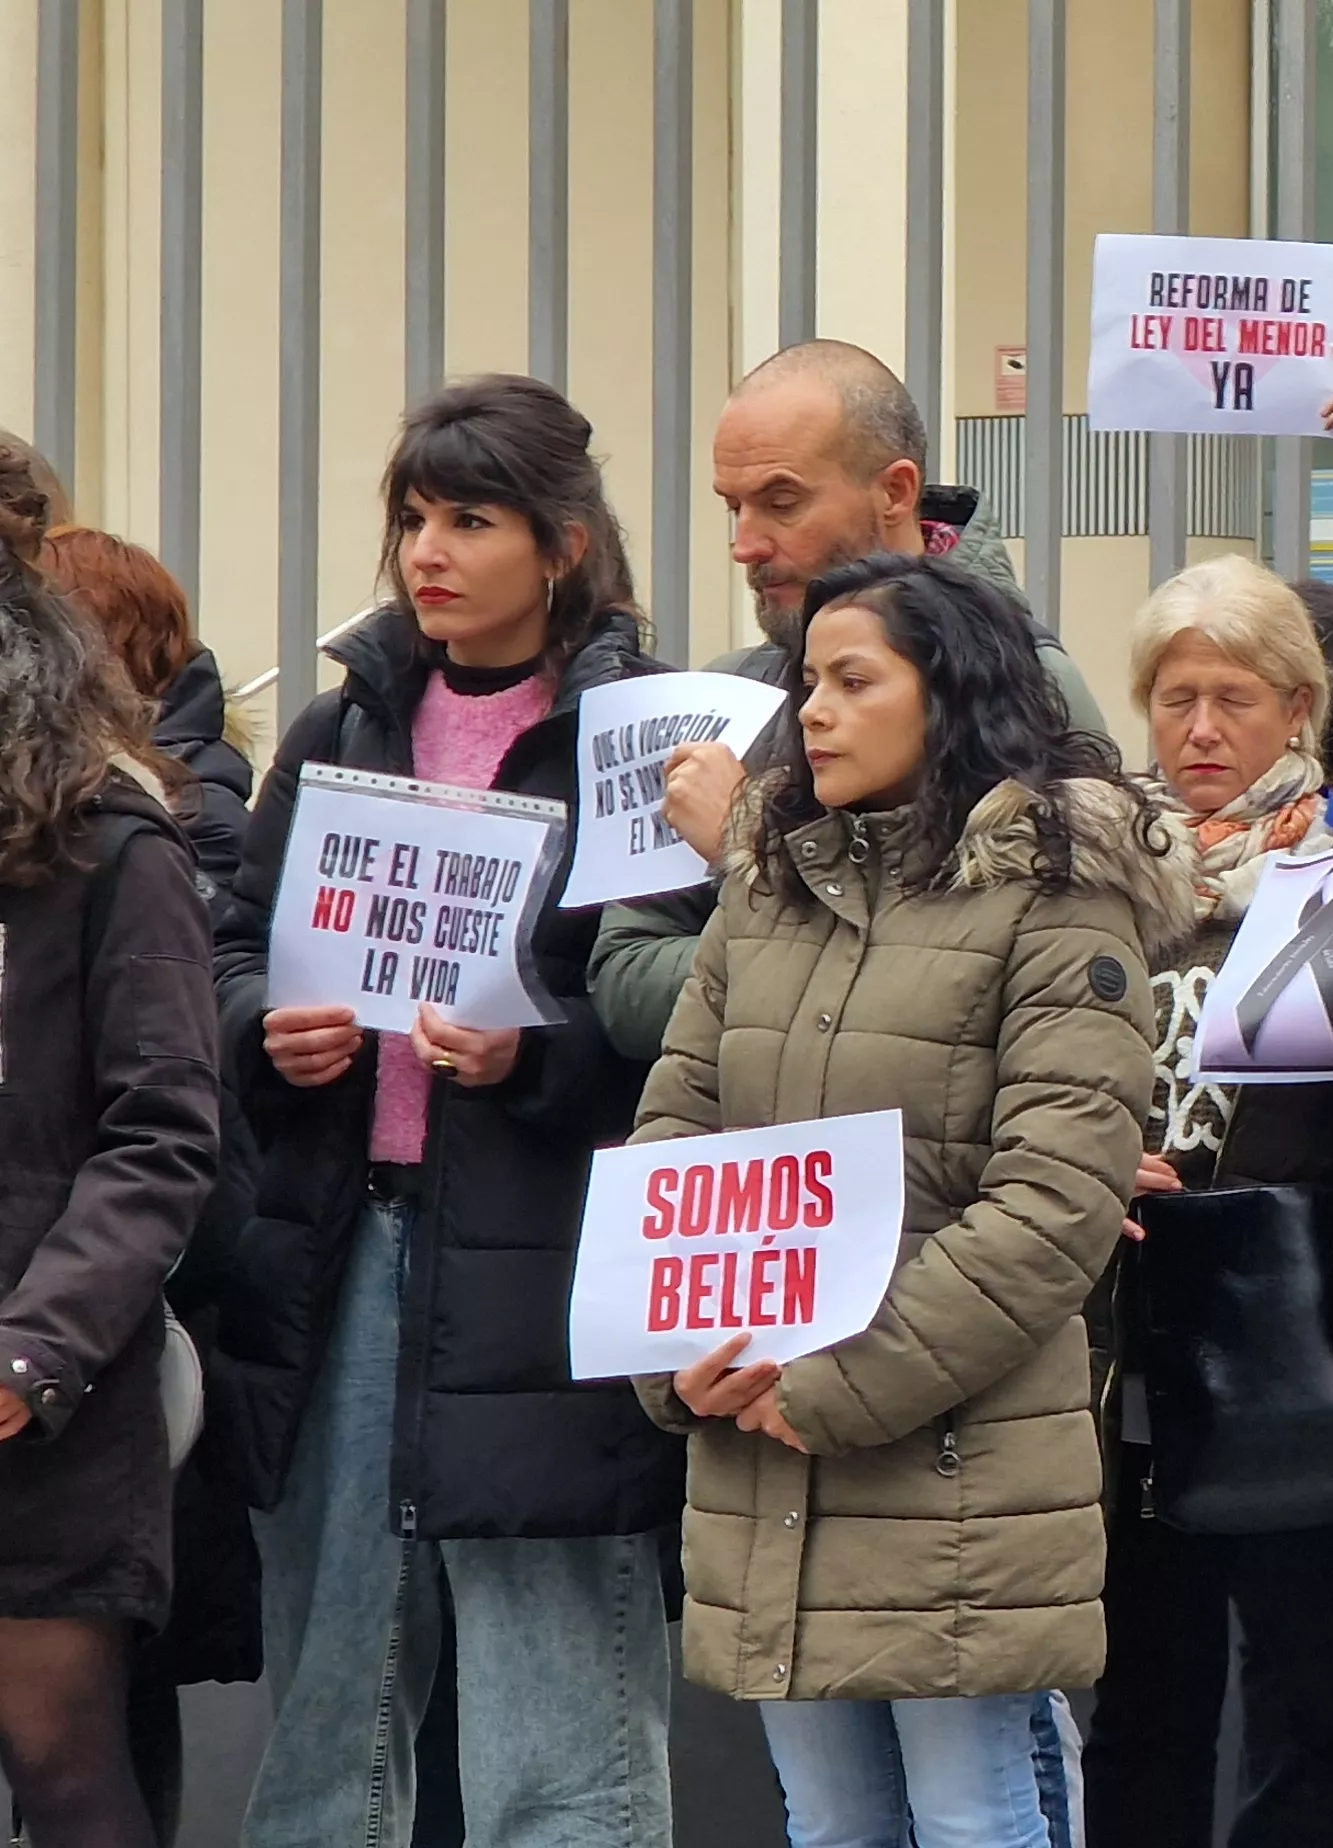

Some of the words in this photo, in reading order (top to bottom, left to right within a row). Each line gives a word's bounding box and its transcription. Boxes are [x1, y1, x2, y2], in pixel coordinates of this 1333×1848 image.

[1150, 272, 1268, 312] REFORMA
[1280, 279, 1313, 314] DE
[1130, 314, 1174, 350] LEY
[1184, 317, 1227, 352] DEL
[1237, 320, 1327, 358] MENOR
[1210, 361, 1255, 411] YA
[592, 728, 618, 773] QUE
[619, 723, 635, 763] LA
[639, 708, 731, 757] VOCACIÓN
[595, 778, 615, 818] NO
[619, 771, 638, 812] SE
[630, 816, 645, 855] EL
[317, 833, 380, 882] QUE
[388, 843, 420, 889] EL
[433, 850, 522, 907] TRABAJO
[311, 886, 356, 932] NO
[364, 894, 427, 944] NOS
[434, 905, 504, 956] CUESTE
[360, 948, 399, 996] LA
[409, 956, 461, 1005] VIDA
[642, 1150, 833, 1240] SOMOS
[647, 1235, 817, 1333] BELÉN
